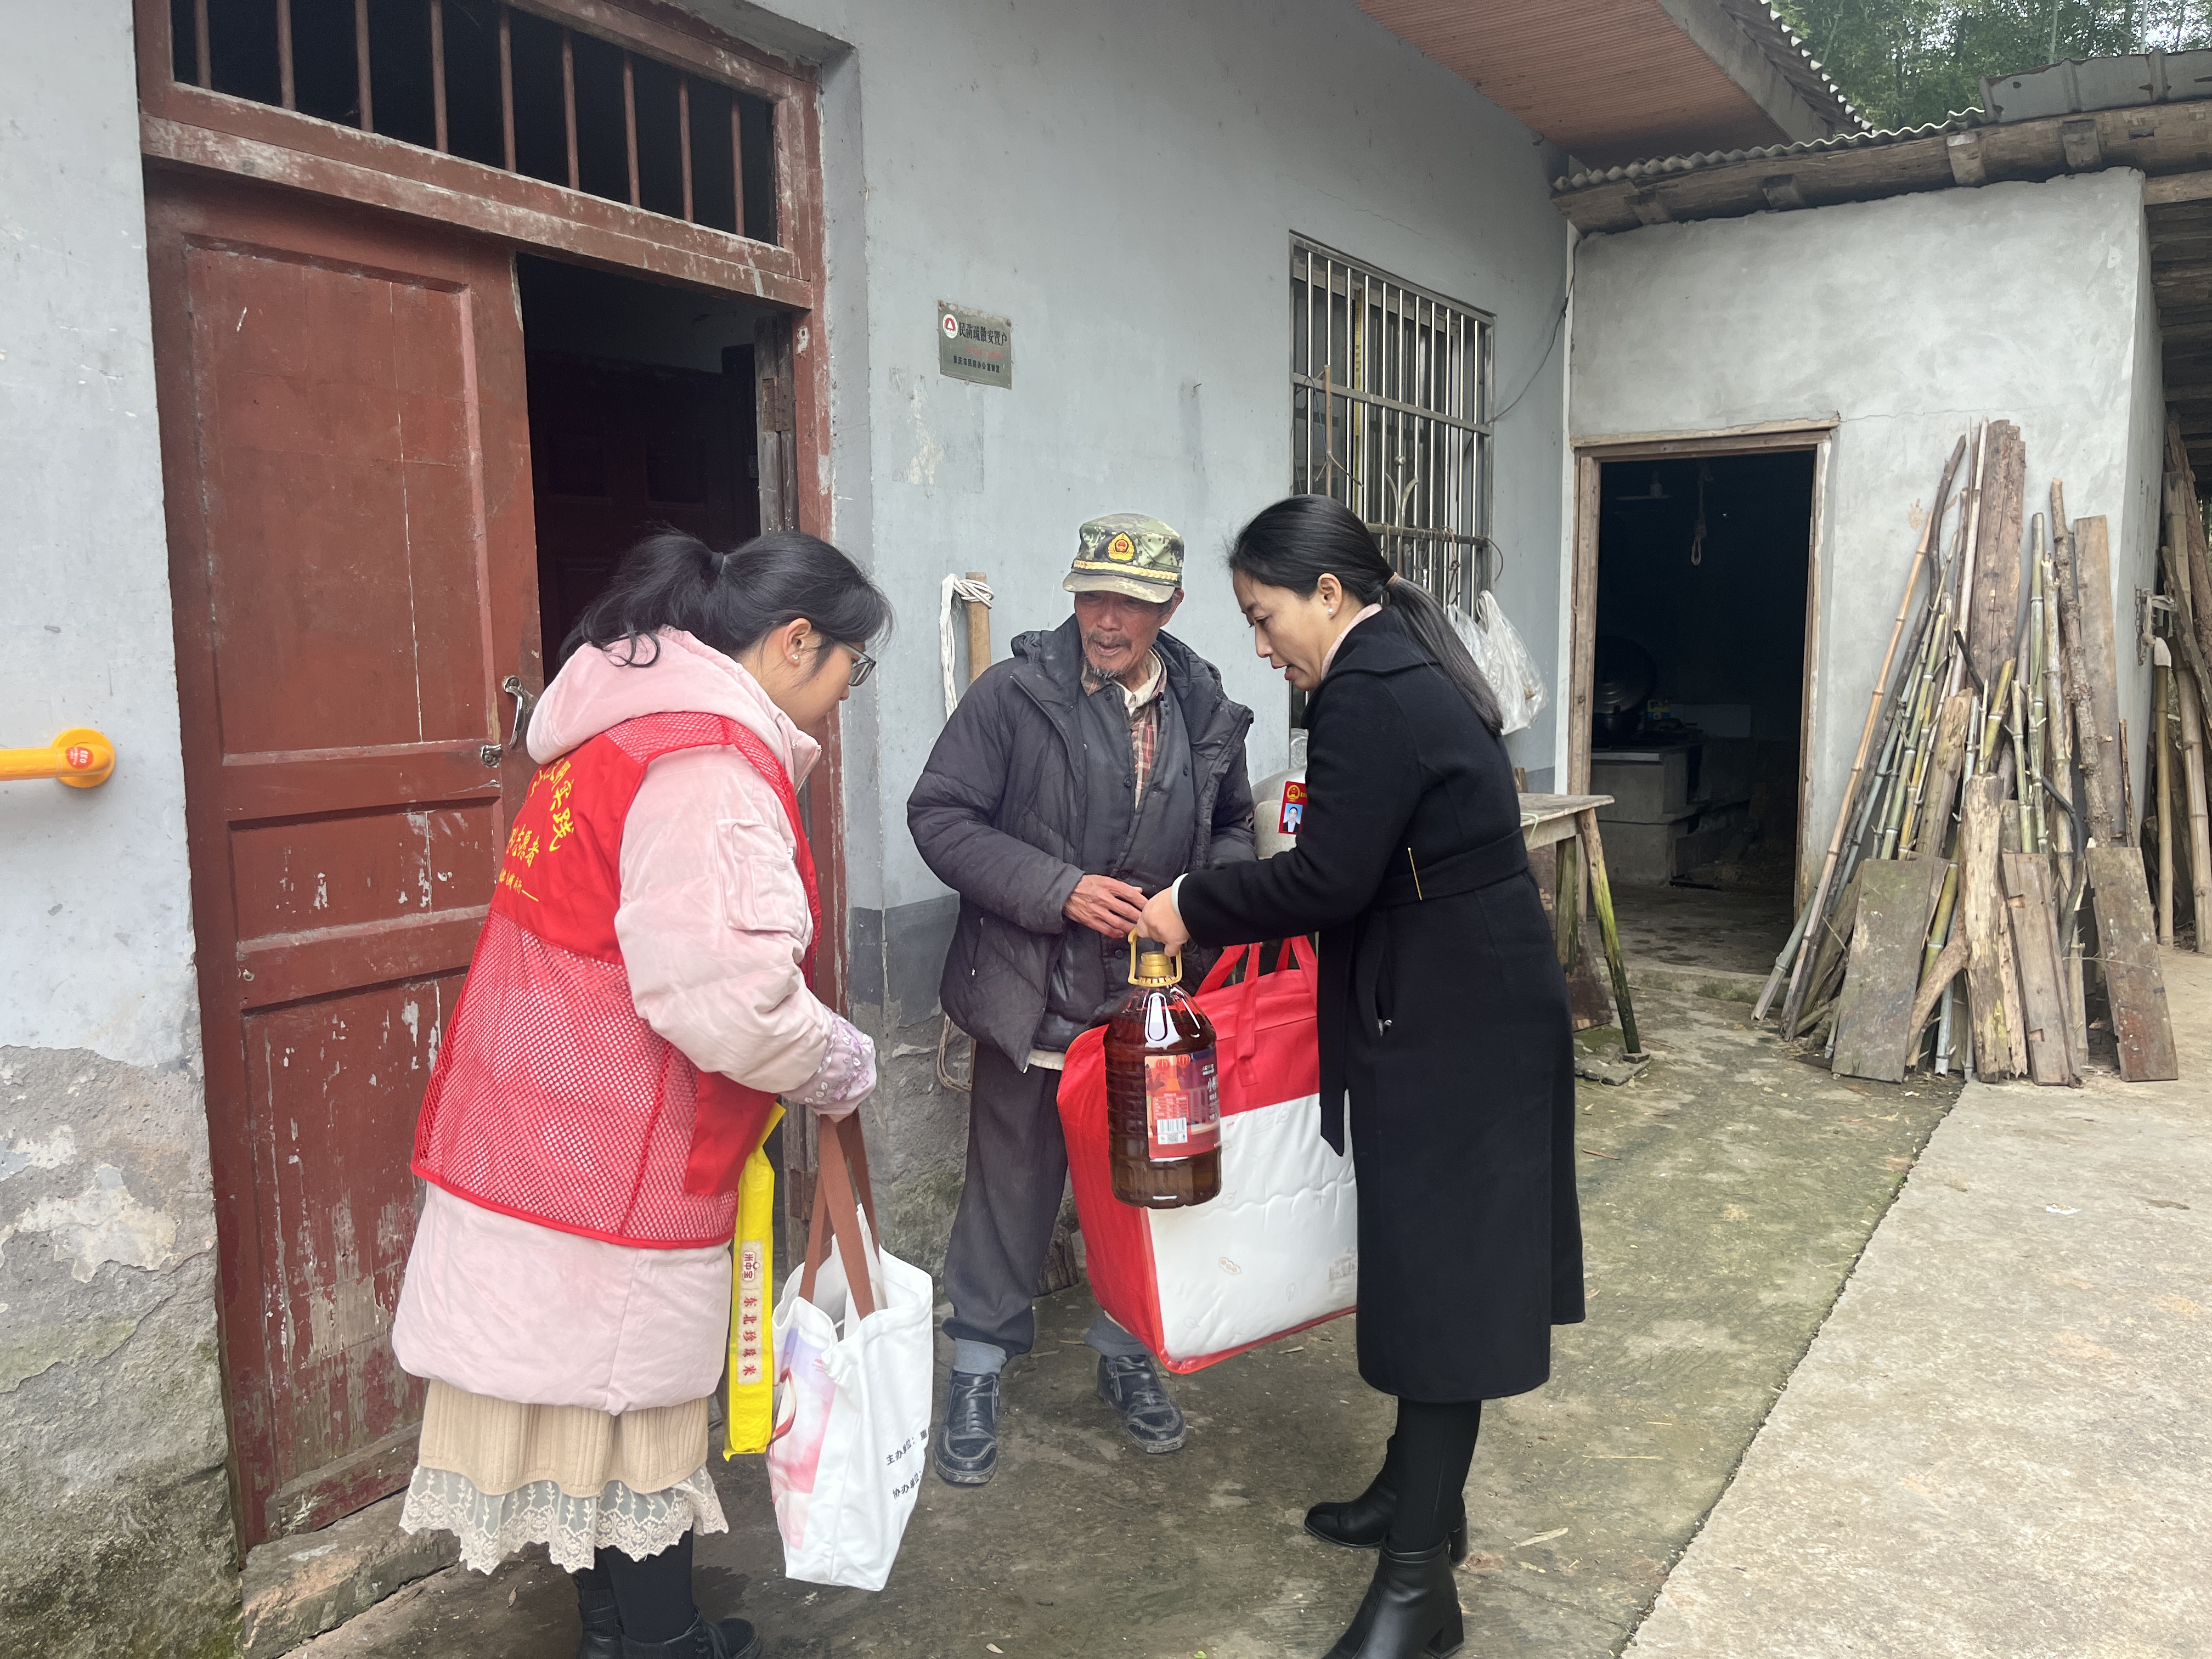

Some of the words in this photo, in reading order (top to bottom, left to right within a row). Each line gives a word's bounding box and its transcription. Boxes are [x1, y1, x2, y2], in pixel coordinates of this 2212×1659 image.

[958, 321, 1007, 347] 民防疏散安置户
[80, 750, 88, 764] 033
[743, 1253, 754, 1279] 米中宝
[742, 1296, 758, 1376] 东北珍珠米
